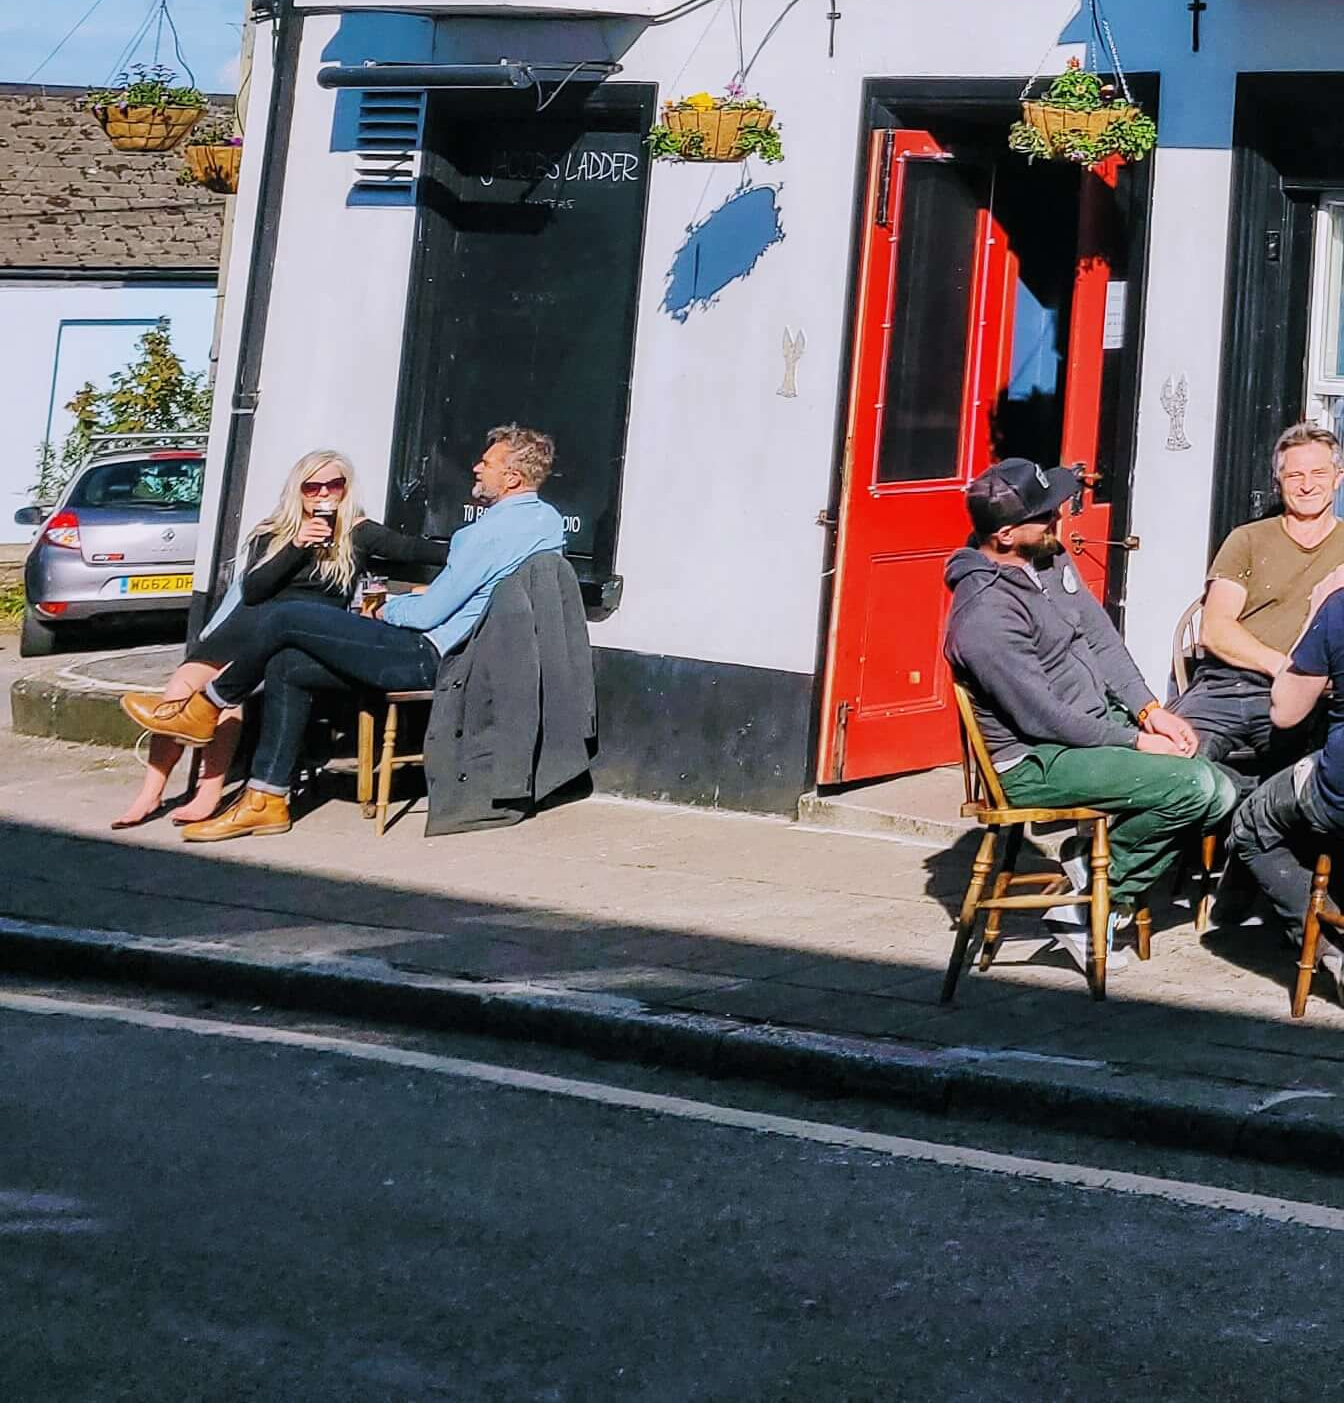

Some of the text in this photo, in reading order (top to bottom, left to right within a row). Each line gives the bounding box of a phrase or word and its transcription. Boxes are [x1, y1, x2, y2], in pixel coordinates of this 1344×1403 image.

[564, 151, 640, 182] LADDER
[463, 504, 474, 522] TO
[130, 577, 170, 590] WG62
